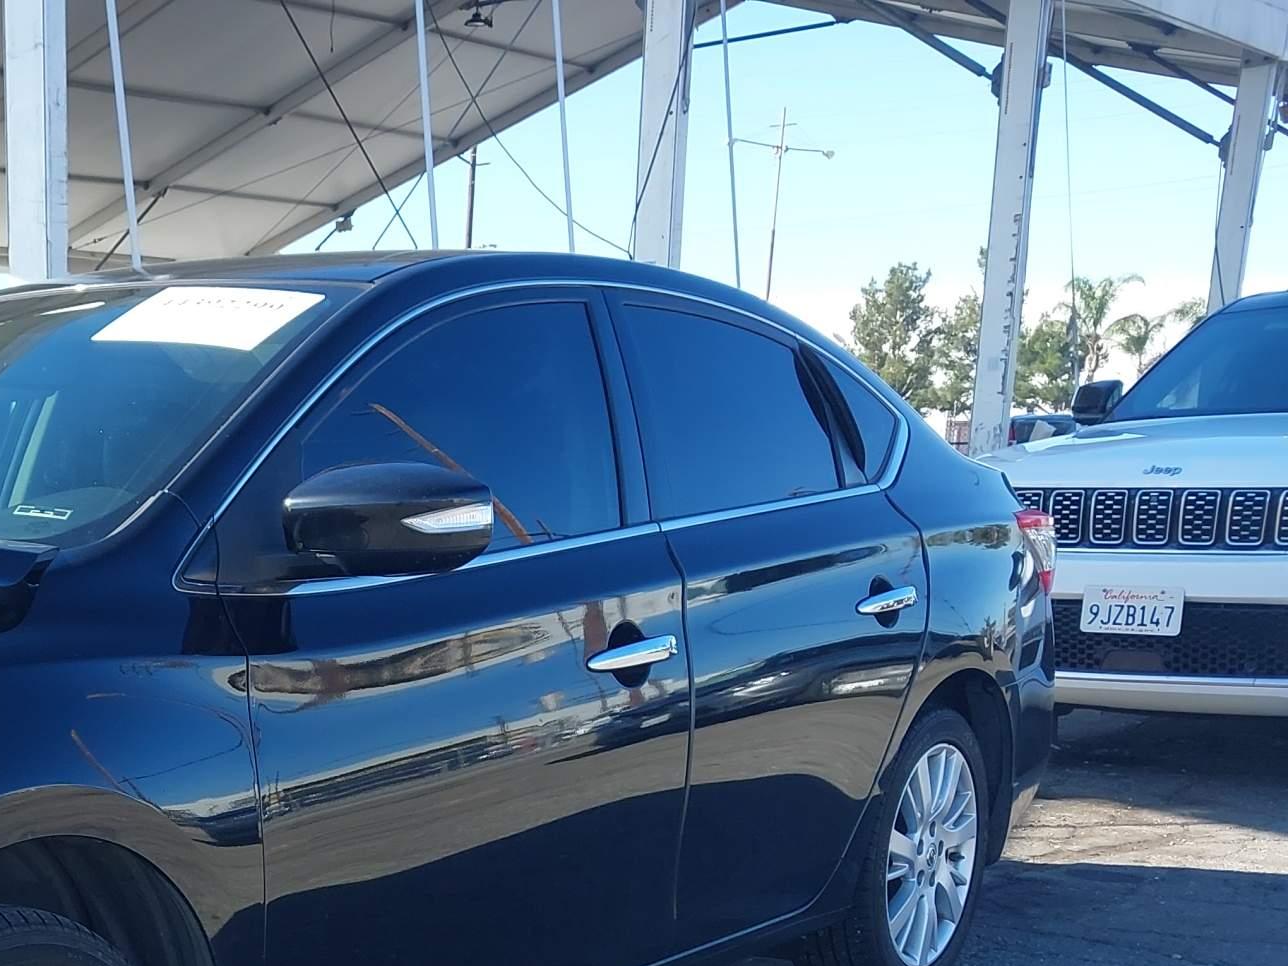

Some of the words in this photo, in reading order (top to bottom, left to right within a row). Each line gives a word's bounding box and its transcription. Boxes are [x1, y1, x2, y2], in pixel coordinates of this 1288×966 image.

[1142, 464, 1183, 477] Jeep
[1103, 588, 1164, 603] California
[1087, 603, 1175, 628] 9JZB147
